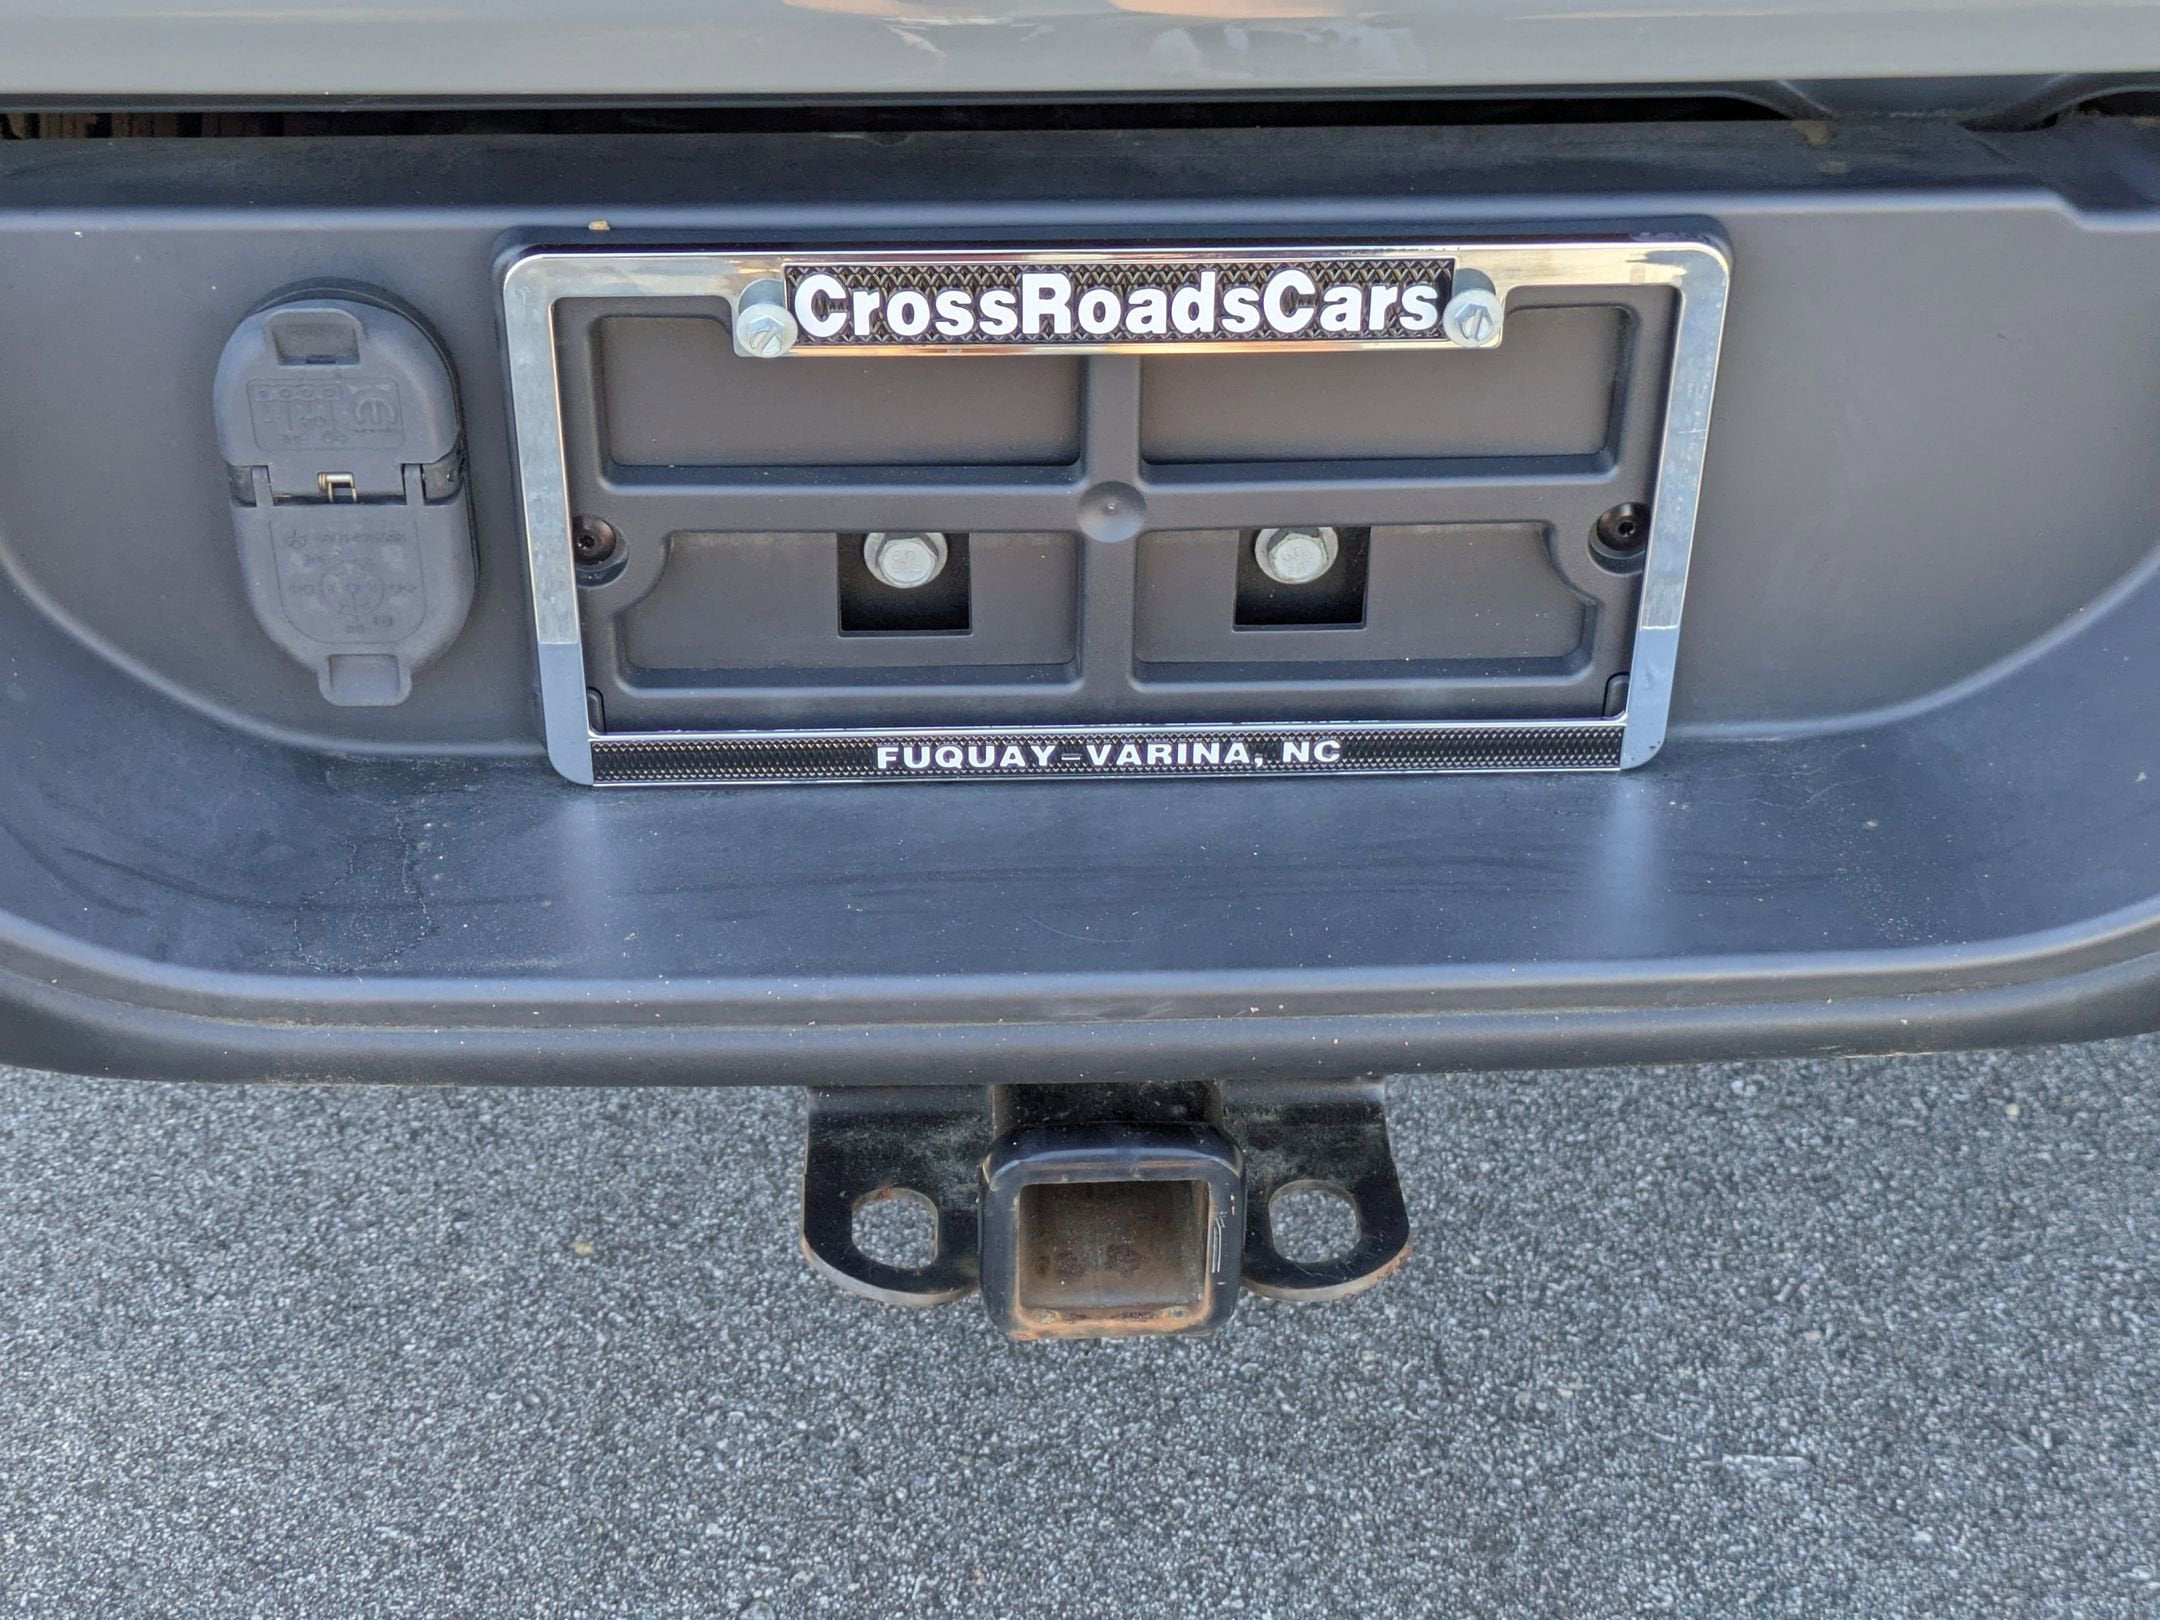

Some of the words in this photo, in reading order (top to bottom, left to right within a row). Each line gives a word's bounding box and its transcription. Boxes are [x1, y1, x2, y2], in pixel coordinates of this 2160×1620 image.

[793, 269, 1439, 338] CrossRoadsCars
[876, 743, 1264, 769] FUQUAY-VARINA,
[1281, 739, 1342, 763] NC
